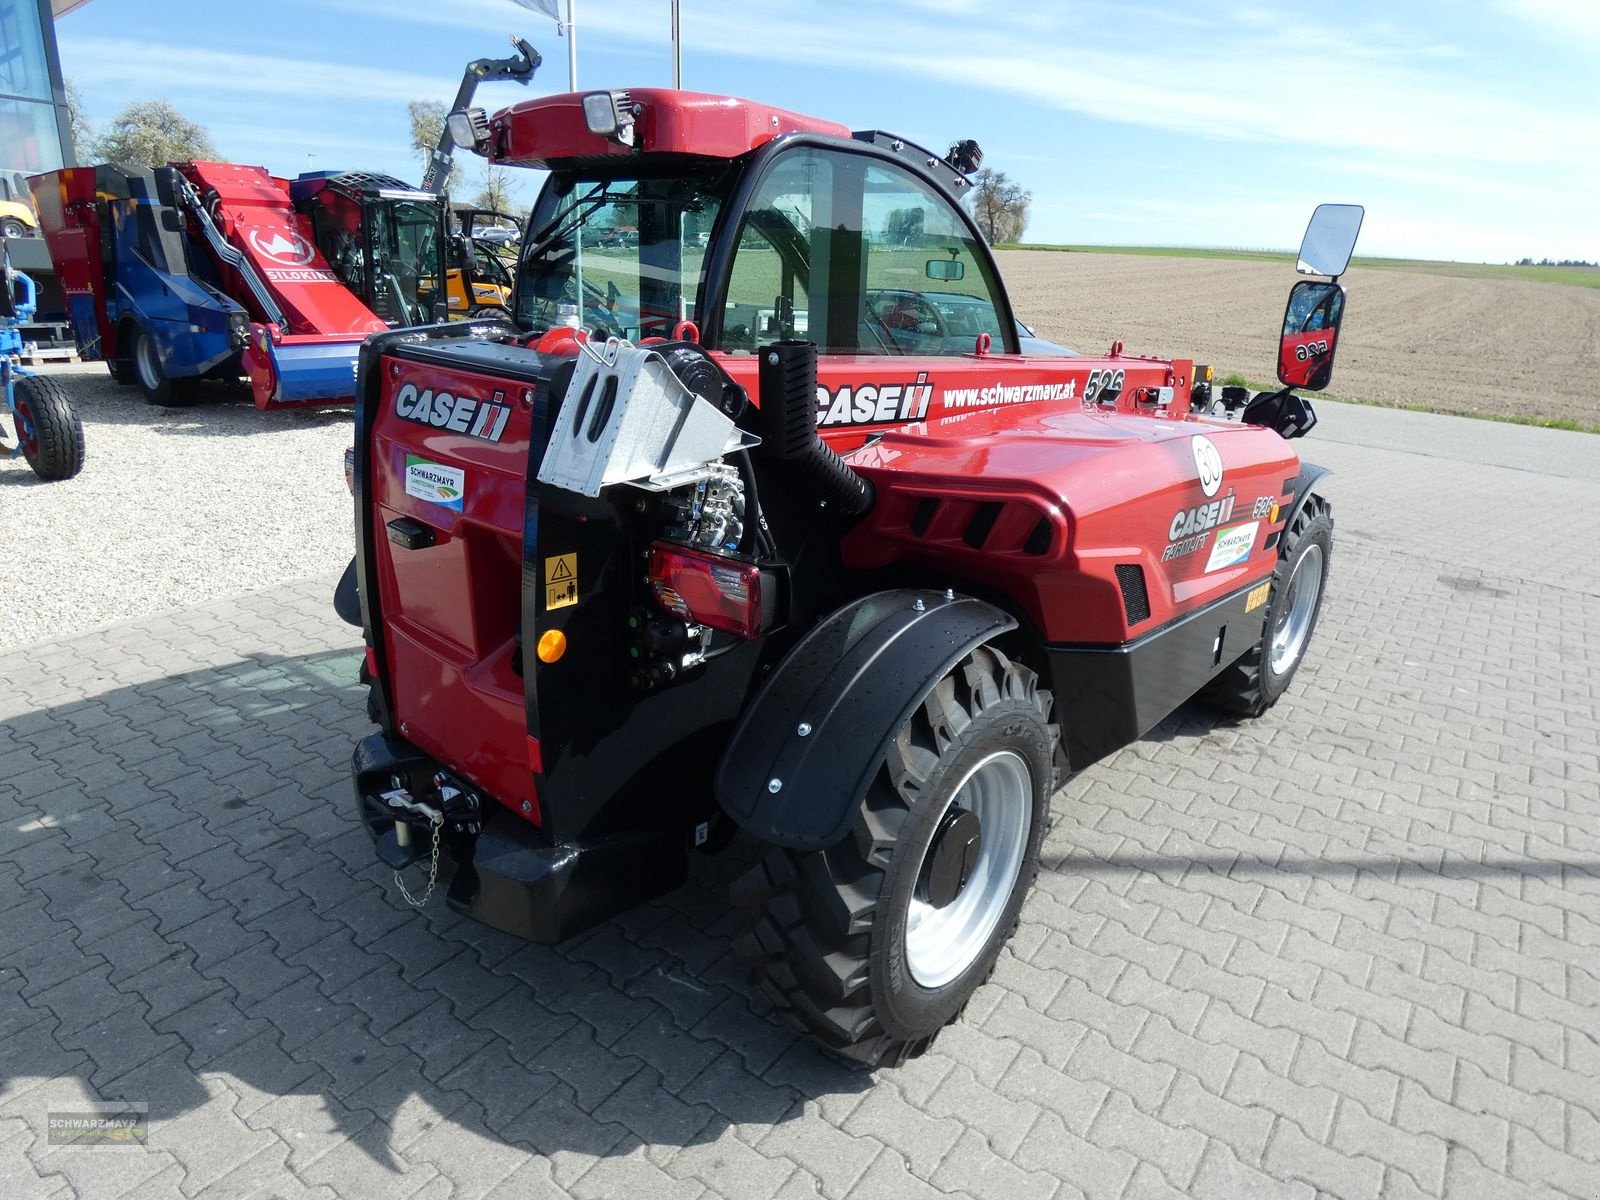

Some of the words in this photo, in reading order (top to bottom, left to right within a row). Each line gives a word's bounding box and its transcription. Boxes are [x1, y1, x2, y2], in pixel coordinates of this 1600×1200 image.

[266, 270, 337, 280] SILOKING
[943, 378, 1076, 408] www.schwarzmayr.at
[1084, 369, 1126, 403] 526
[396, 384, 477, 433] CASE
[815, 386, 902, 426] CASE
[410, 467, 455, 487] SCHWARZMAYR
[1197, 444, 1220, 486] 30
[1169, 501, 1220, 541] CASE
[1252, 496, 1275, 519] 526
[1161, 532, 1211, 562] FARMLIFT
[1217, 533, 1251, 550] SCHWARZMAYR
